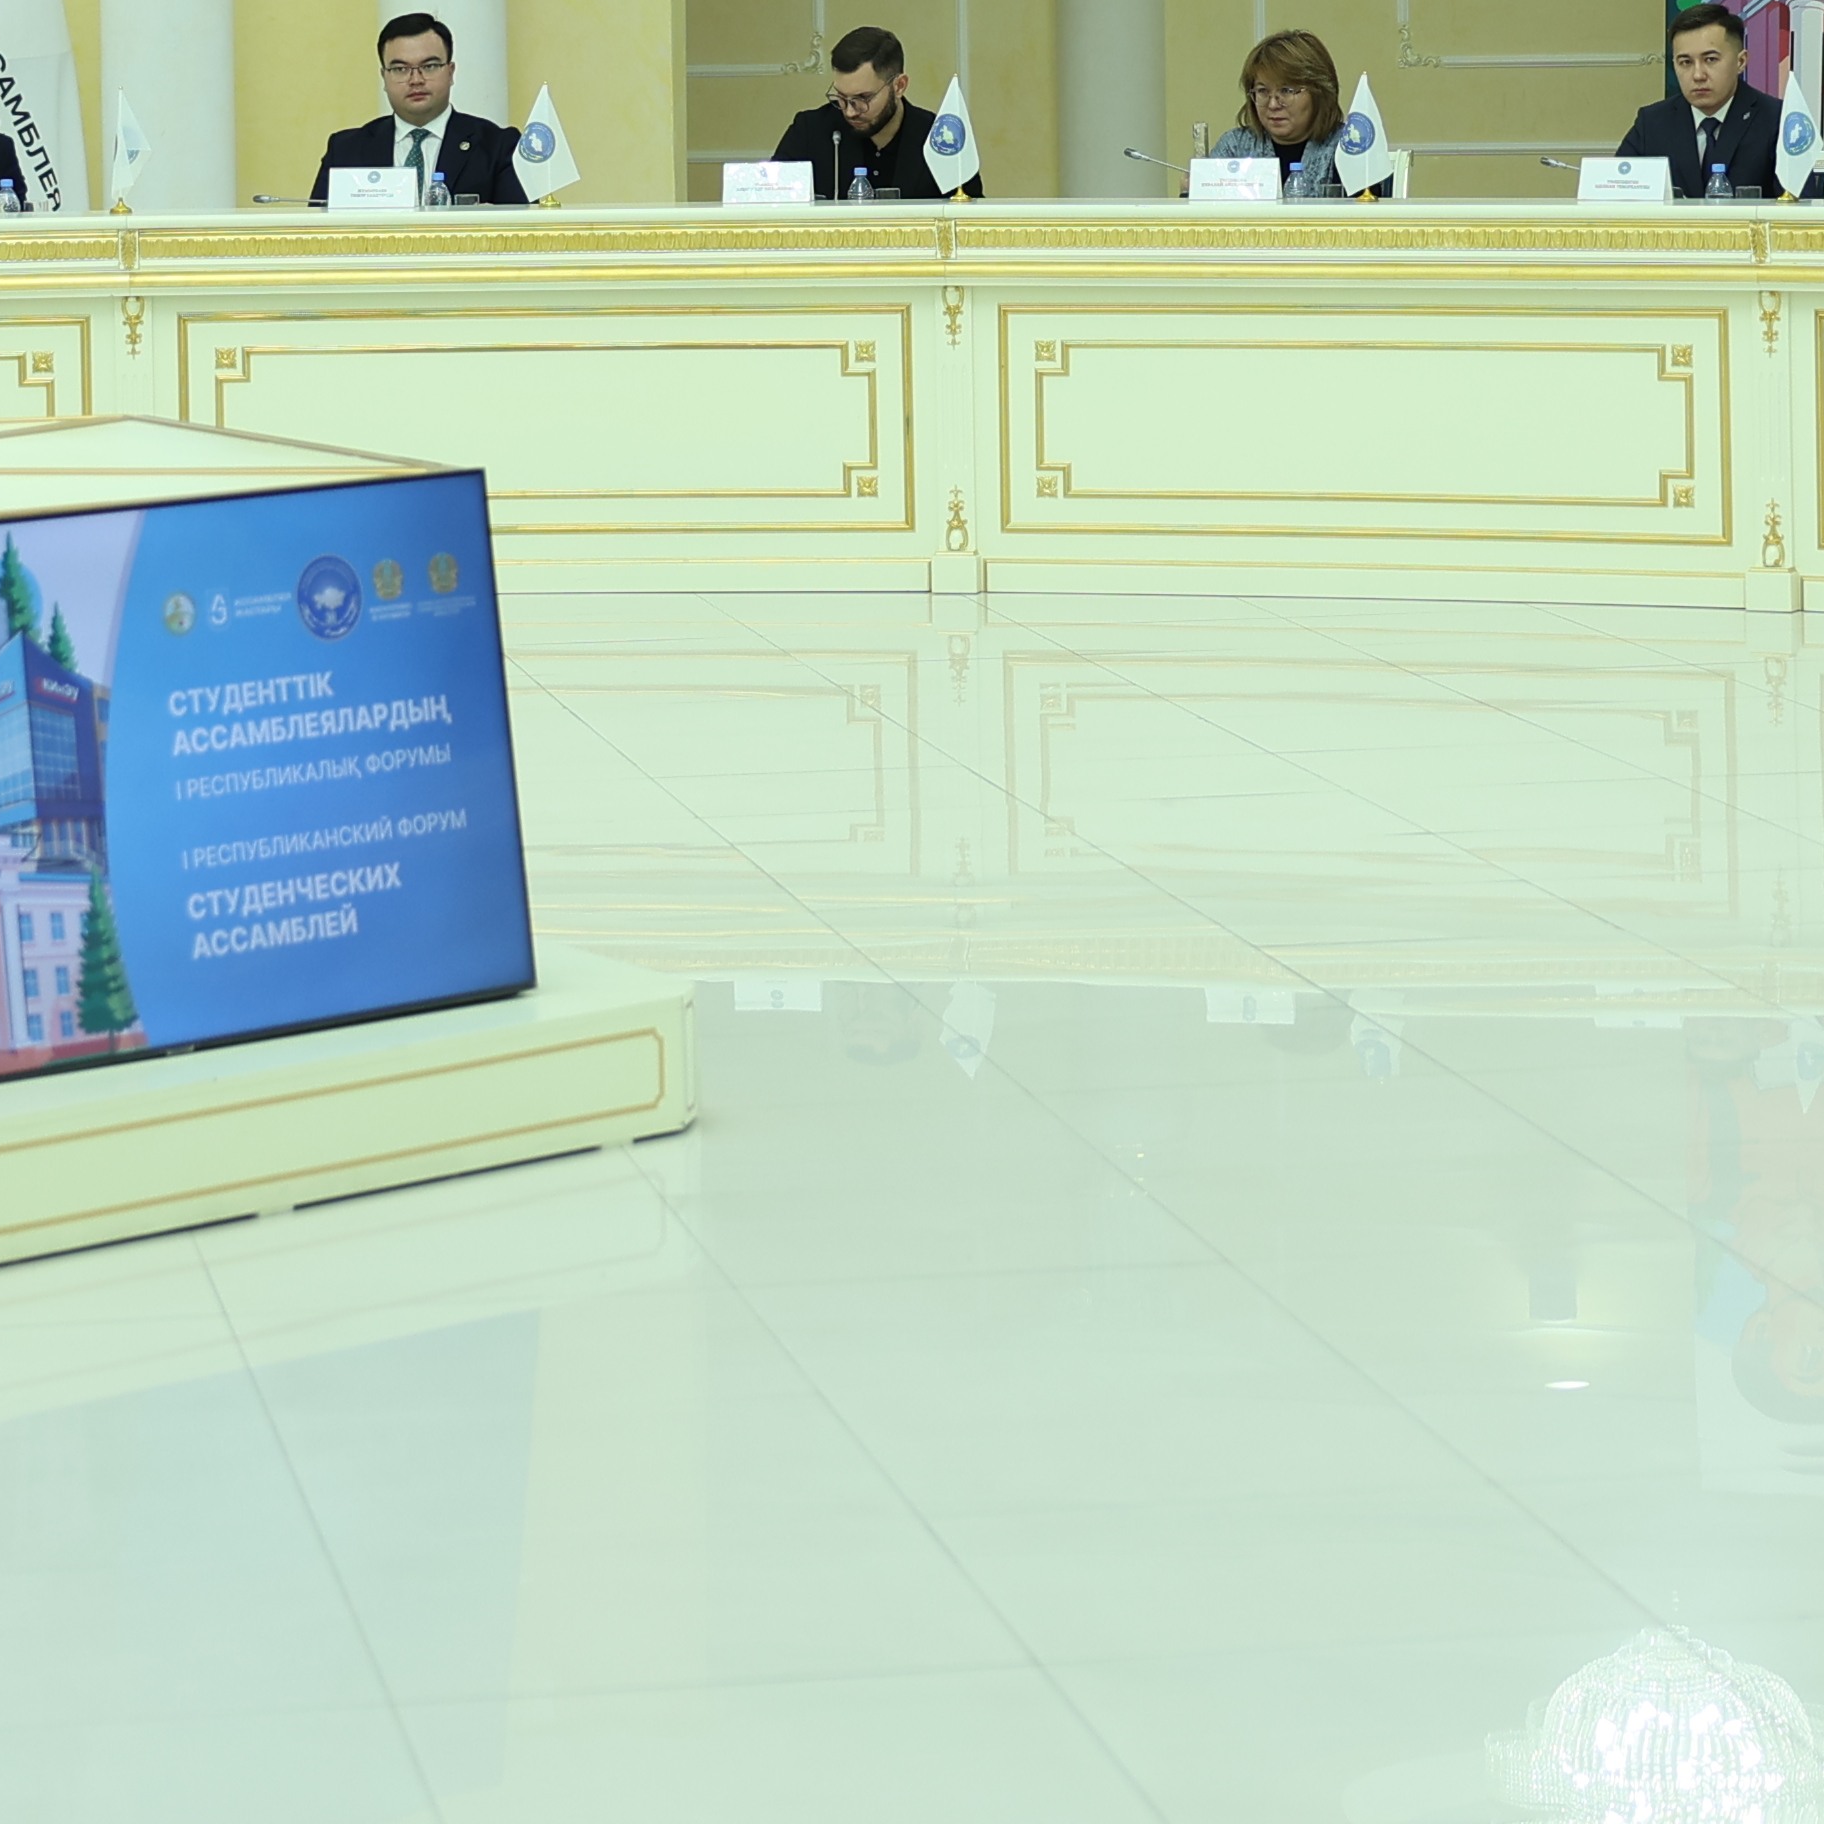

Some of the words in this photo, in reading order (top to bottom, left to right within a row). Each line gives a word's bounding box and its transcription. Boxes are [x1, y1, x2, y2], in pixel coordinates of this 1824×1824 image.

[169, 671, 334, 716] СТУДЕНТТІК
[174, 694, 453, 756] АССАМБЛЕЯЛАРДЫҢ
[188, 755, 362, 799] РЕСПУБЛИКАЛЫҚ
[366, 743, 452, 774] ФОРУМЫ
[194, 815, 393, 868] РЕСПУБЛИКАНСКИЙ
[398, 808, 468, 838] ФОРУМ
[188, 862, 402, 920] СТУДЕНЧЕСКИХ
[193, 903, 359, 960] АССАМБЛЕЙ
